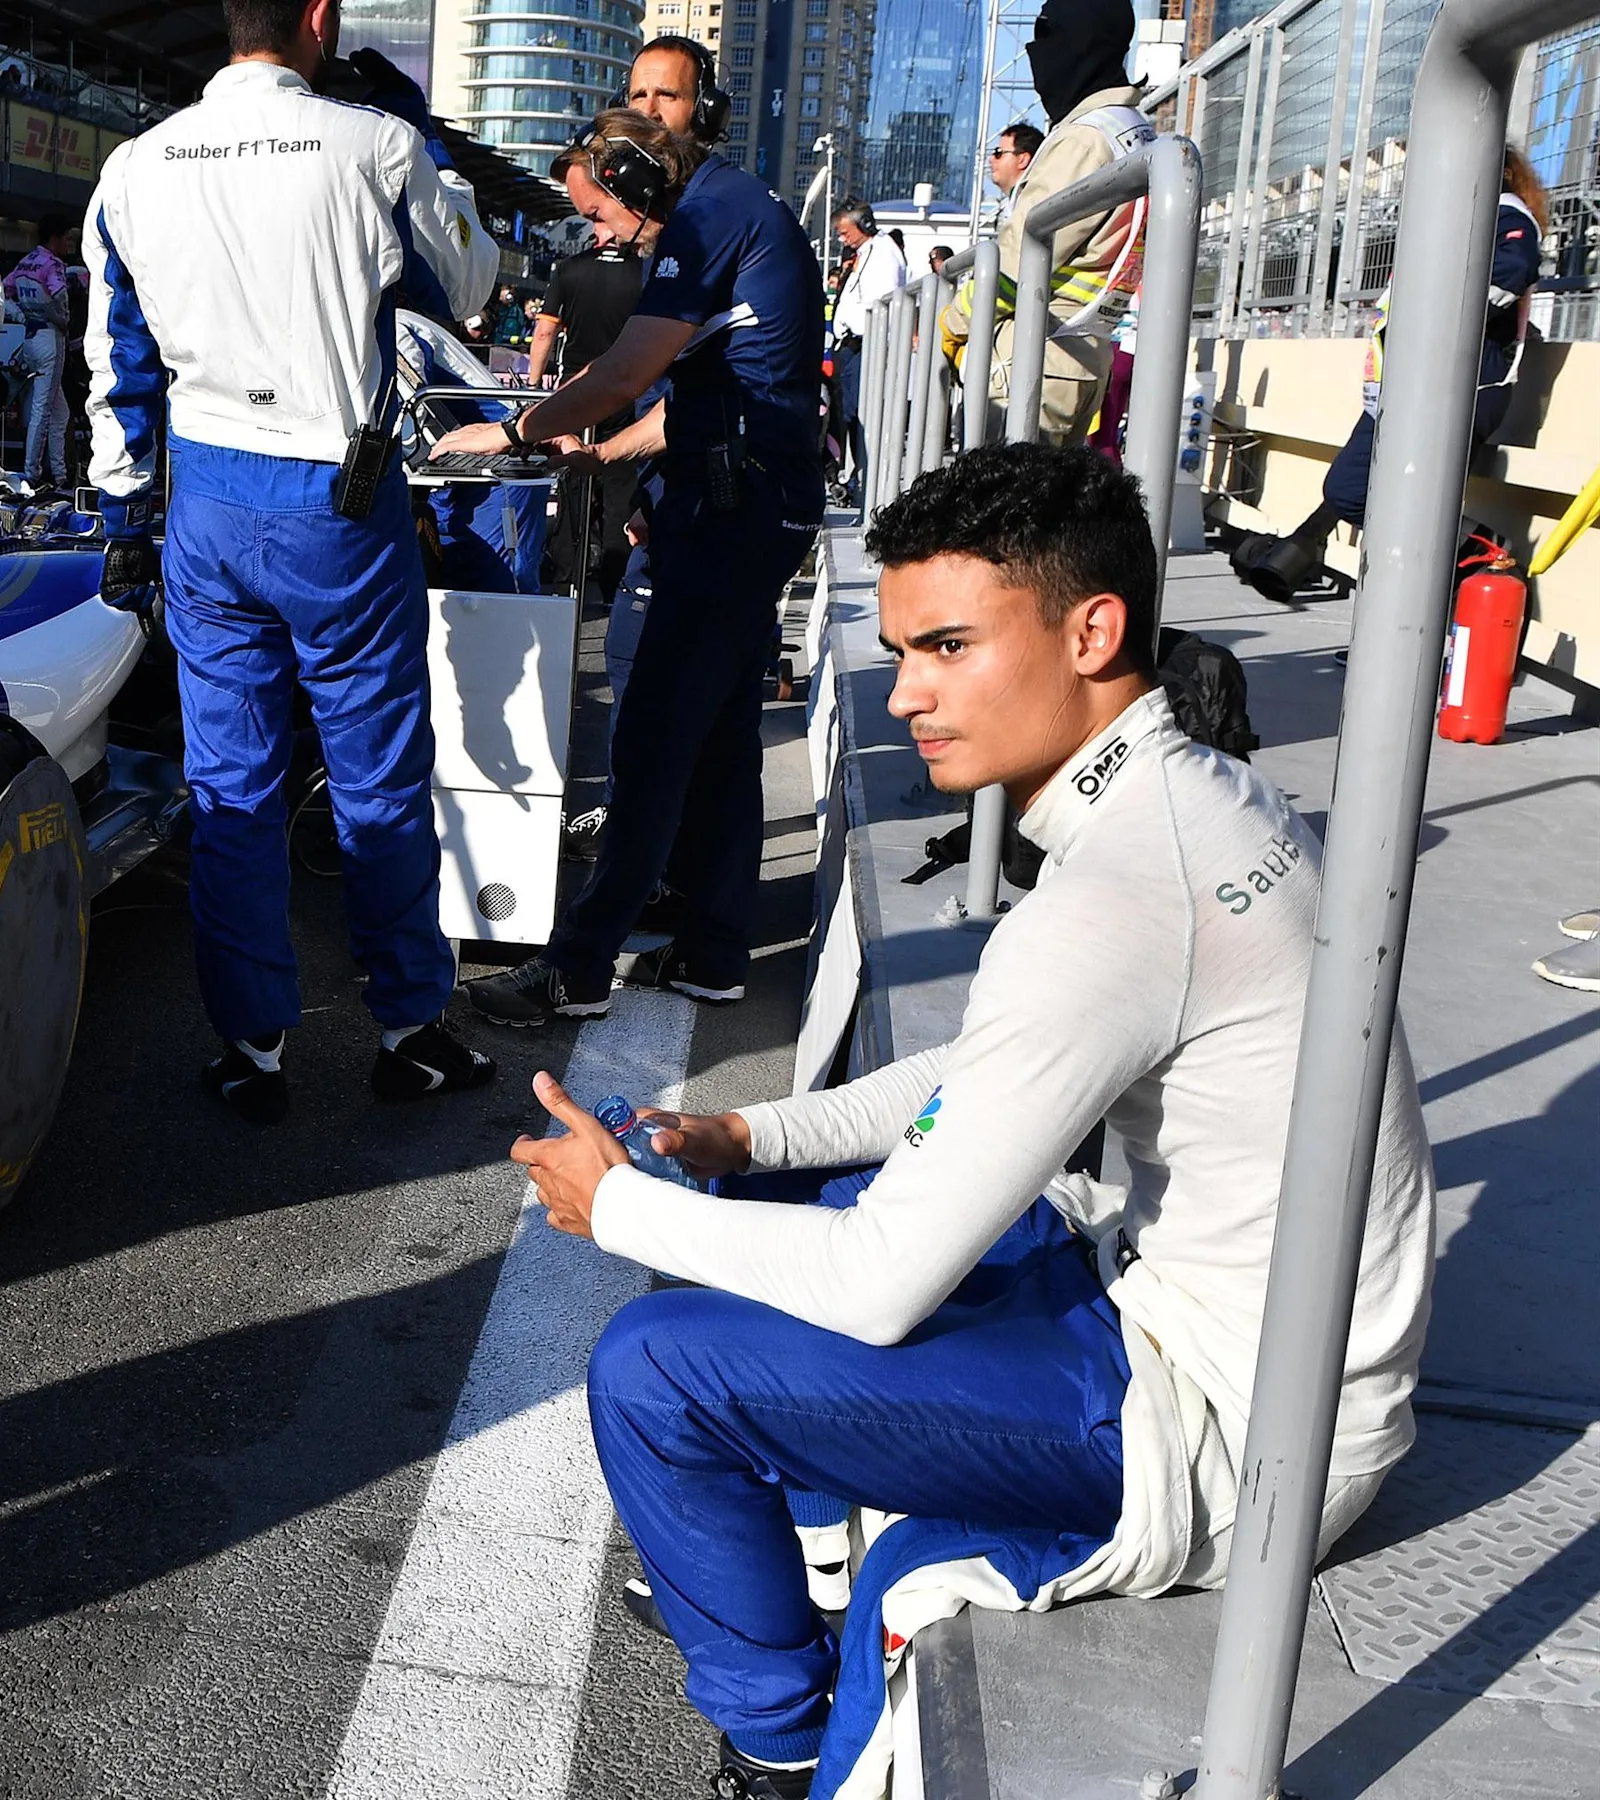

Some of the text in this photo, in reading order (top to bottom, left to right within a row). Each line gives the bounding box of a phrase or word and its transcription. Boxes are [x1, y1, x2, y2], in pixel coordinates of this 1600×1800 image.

[25, 116, 81, 167] DHL
[164, 143, 232, 161] Sauber
[266, 138, 321, 154] Team
[248, 392, 275, 403] OMP
[1077, 741, 1129, 796] OMP
